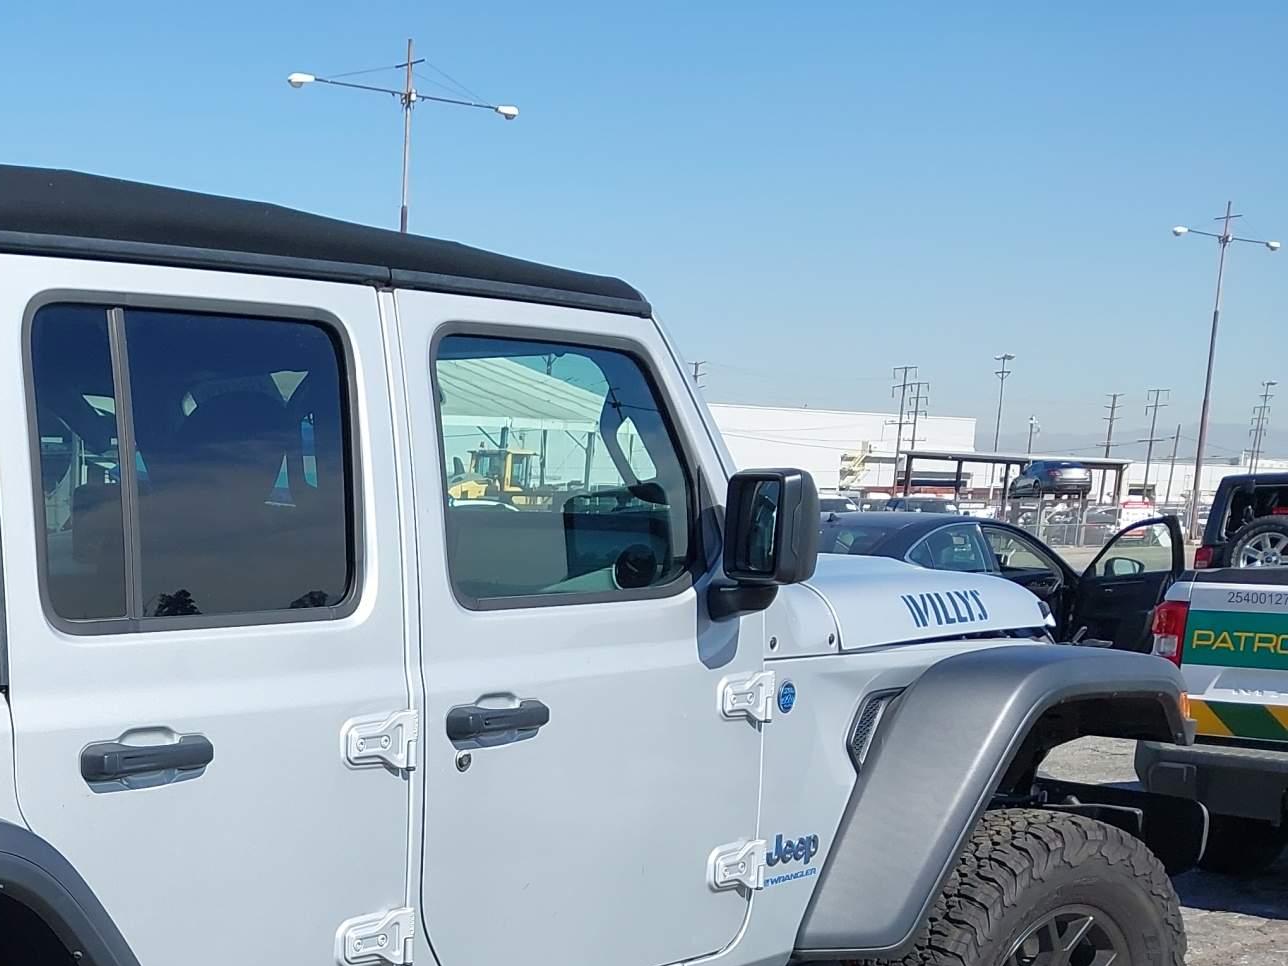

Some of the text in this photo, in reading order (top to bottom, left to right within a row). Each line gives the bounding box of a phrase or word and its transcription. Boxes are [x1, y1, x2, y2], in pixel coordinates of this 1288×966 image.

[901, 589, 989, 628] WILLYS
[766, 834, 819, 867] Jeep
[770, 867, 817, 886] WRANGLER
